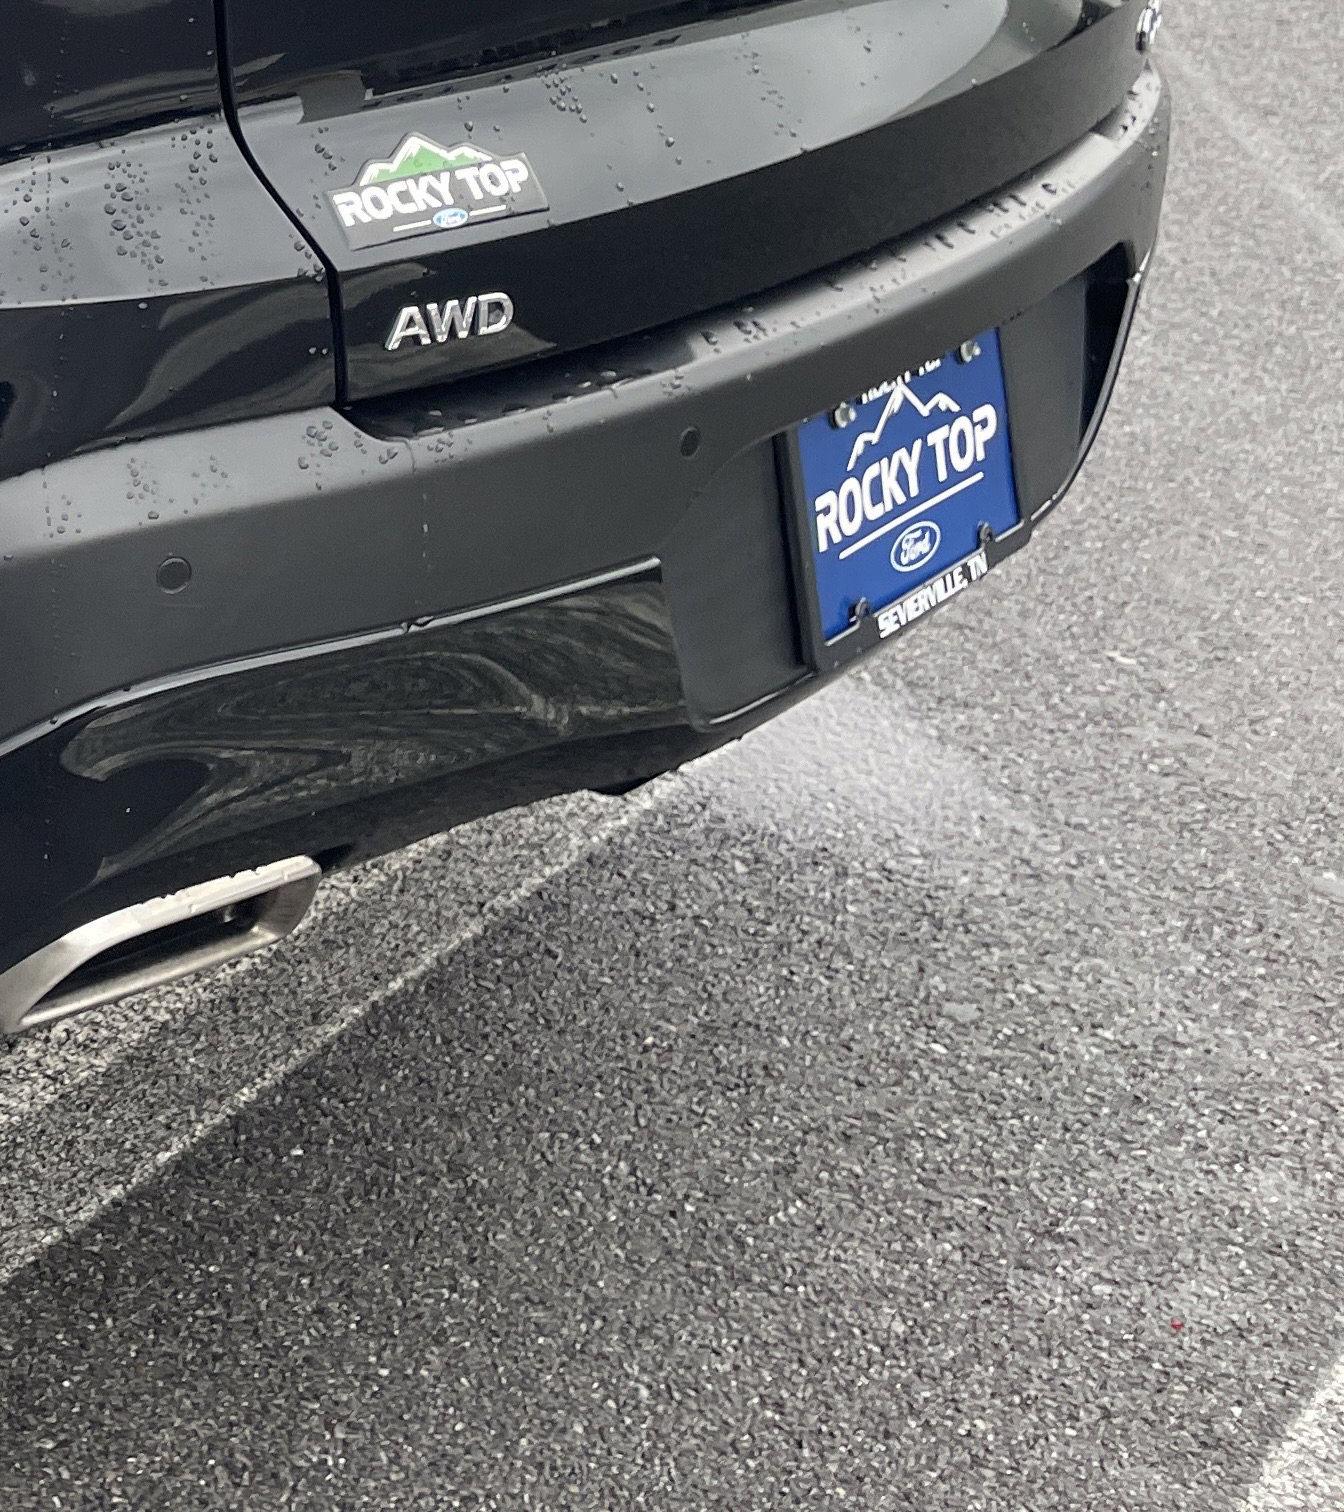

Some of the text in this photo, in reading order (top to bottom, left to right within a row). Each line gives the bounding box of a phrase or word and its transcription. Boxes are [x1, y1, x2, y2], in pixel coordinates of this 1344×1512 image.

[332, 171, 455, 227] ROCKY
[455, 159, 529, 200] TOP
[384, 291, 514, 351] AWD
[814, 403, 998, 553] ROCKY TOP
[899, 529, 931, 565] Ford
[967, 551, 989, 581] TN
